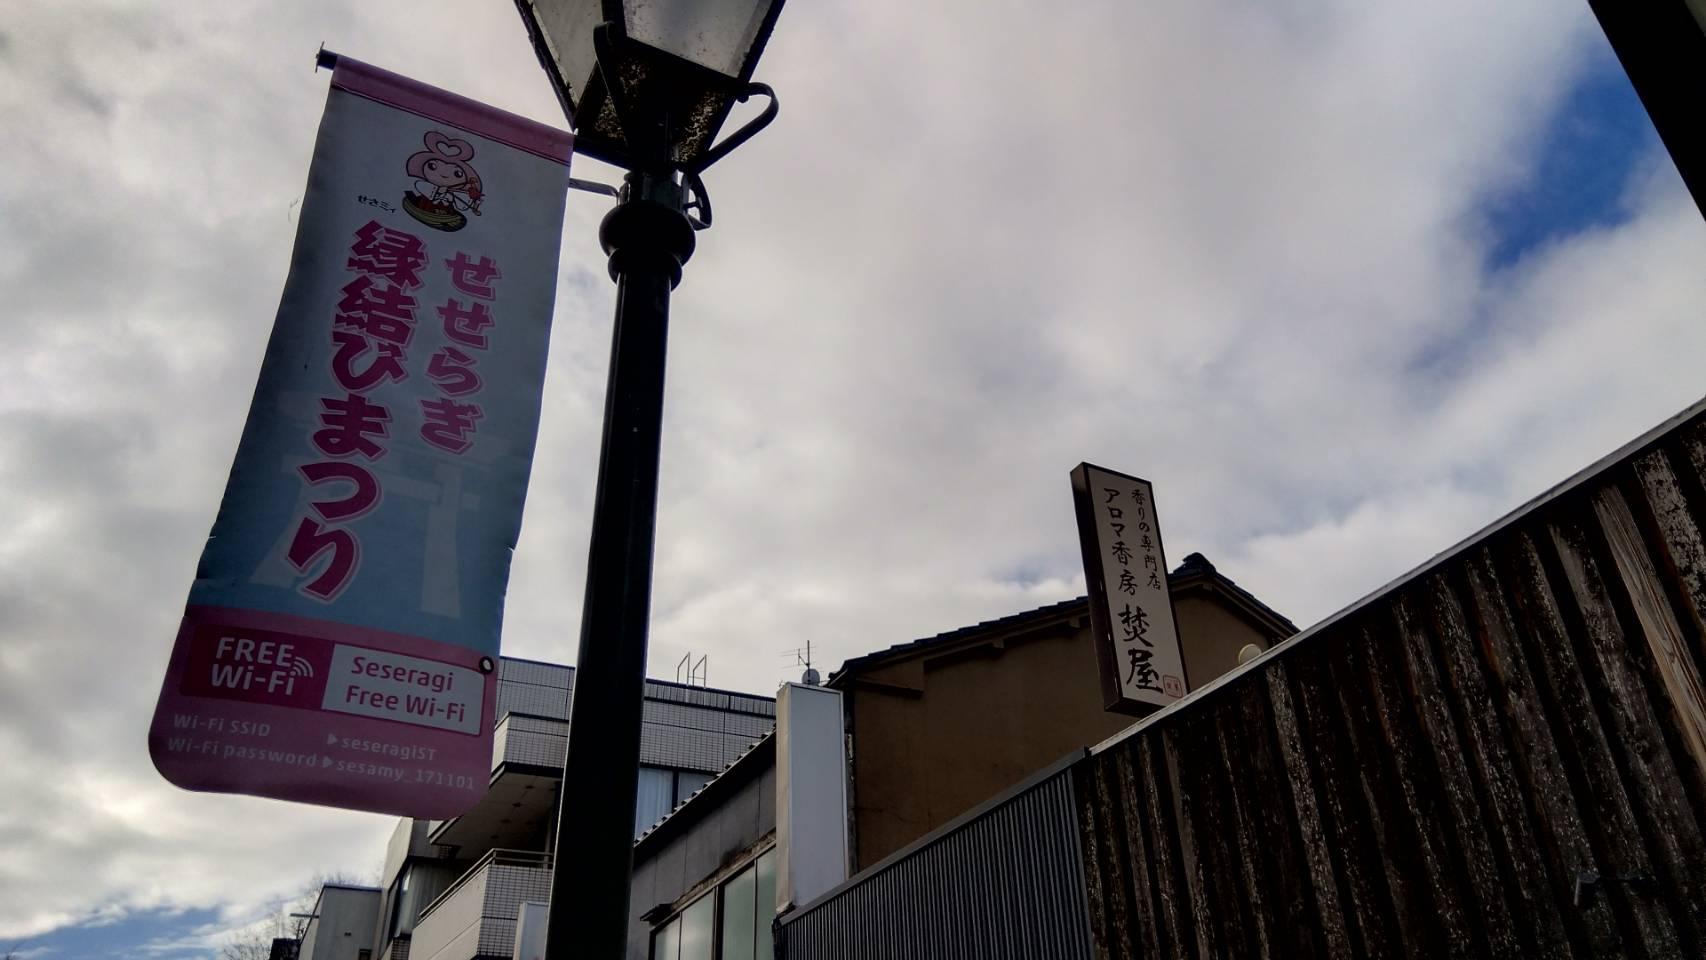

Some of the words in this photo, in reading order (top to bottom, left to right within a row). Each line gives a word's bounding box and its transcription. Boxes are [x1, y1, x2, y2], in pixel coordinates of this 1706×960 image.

[420, 250, 501, 455] せせらぎ
[286, 220, 429, 603] 縁結びまつり
[1103, 487, 1138, 597] アロマ香房
[1132, 489, 1161, 591] 香りの専門店
[215, 637, 295, 667] FREE
[1118, 604, 1164, 694] 焚屋
[211, 662, 296, 696] Wi-Fi
[351, 656, 454, 693] Seseragi
[346, 686, 399, 710] Free
[406, 694, 465, 723] Wi-Fi
[173, 714, 224, 732] Wi-Fi
[229, 720, 271, 737] SSID
[167, 738, 219, 754] Wi-Fi
[224, 744, 317, 767] password
[336, 759, 474, 790] sesamy_171101
